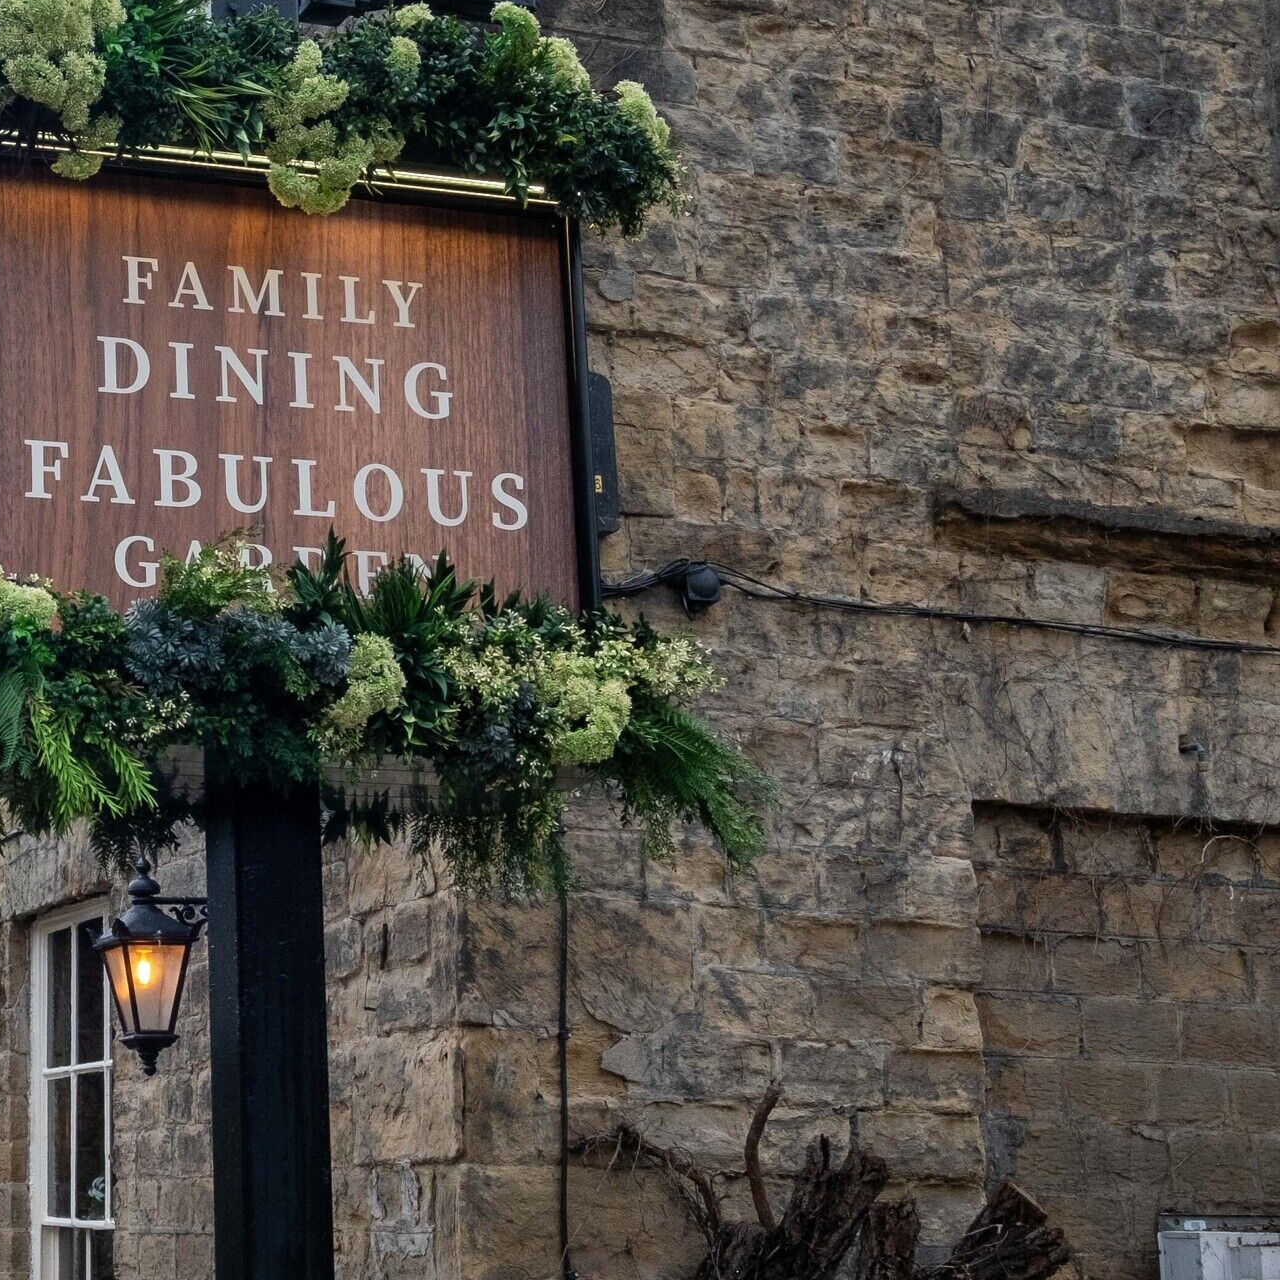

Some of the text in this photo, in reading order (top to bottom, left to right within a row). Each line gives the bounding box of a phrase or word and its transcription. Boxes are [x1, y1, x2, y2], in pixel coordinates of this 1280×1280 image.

[121, 255, 423, 329] FAMILY
[96, 334, 454, 421] DINING
[23, 438, 529, 532] FABULOUS
